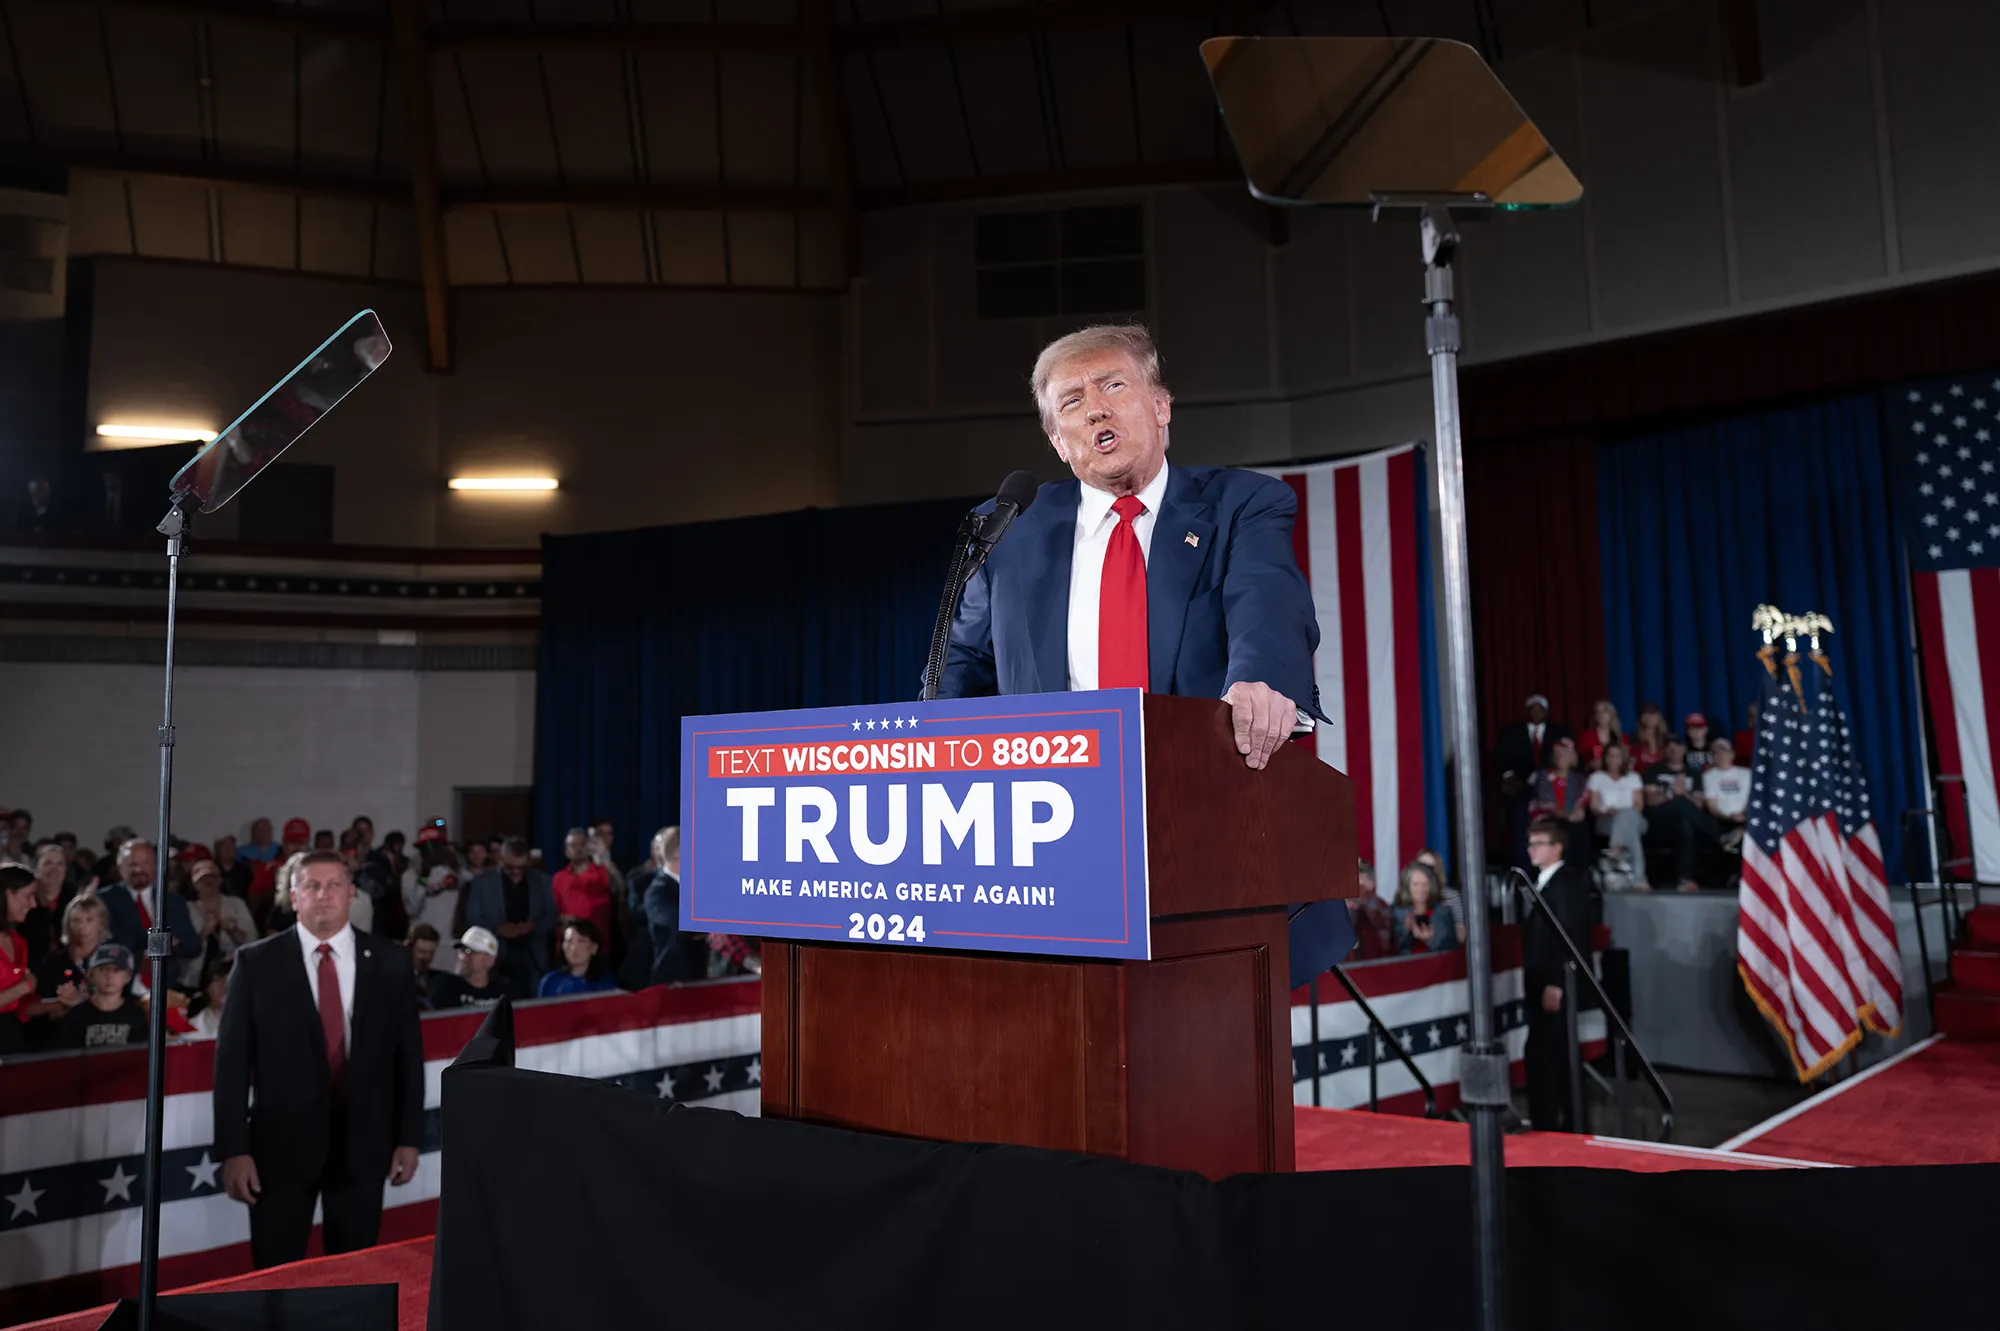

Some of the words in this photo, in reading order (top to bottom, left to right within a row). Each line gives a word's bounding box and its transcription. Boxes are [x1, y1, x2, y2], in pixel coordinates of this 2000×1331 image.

[715, 748, 776, 775] TEXT
[781, 741, 936, 773] WISCONSIN
[943, 739, 983, 768] TO
[992, 734, 1089, 765] 88022
[726, 780, 1075, 867] TRUMP
[741, 878, 793, 897] MAKE
[798, 879, 889, 900] AMERICA
[895, 882, 965, 903] GREAT
[973, 884, 1056, 906] AGAIN!
[848, 912, 926, 941] 2024
